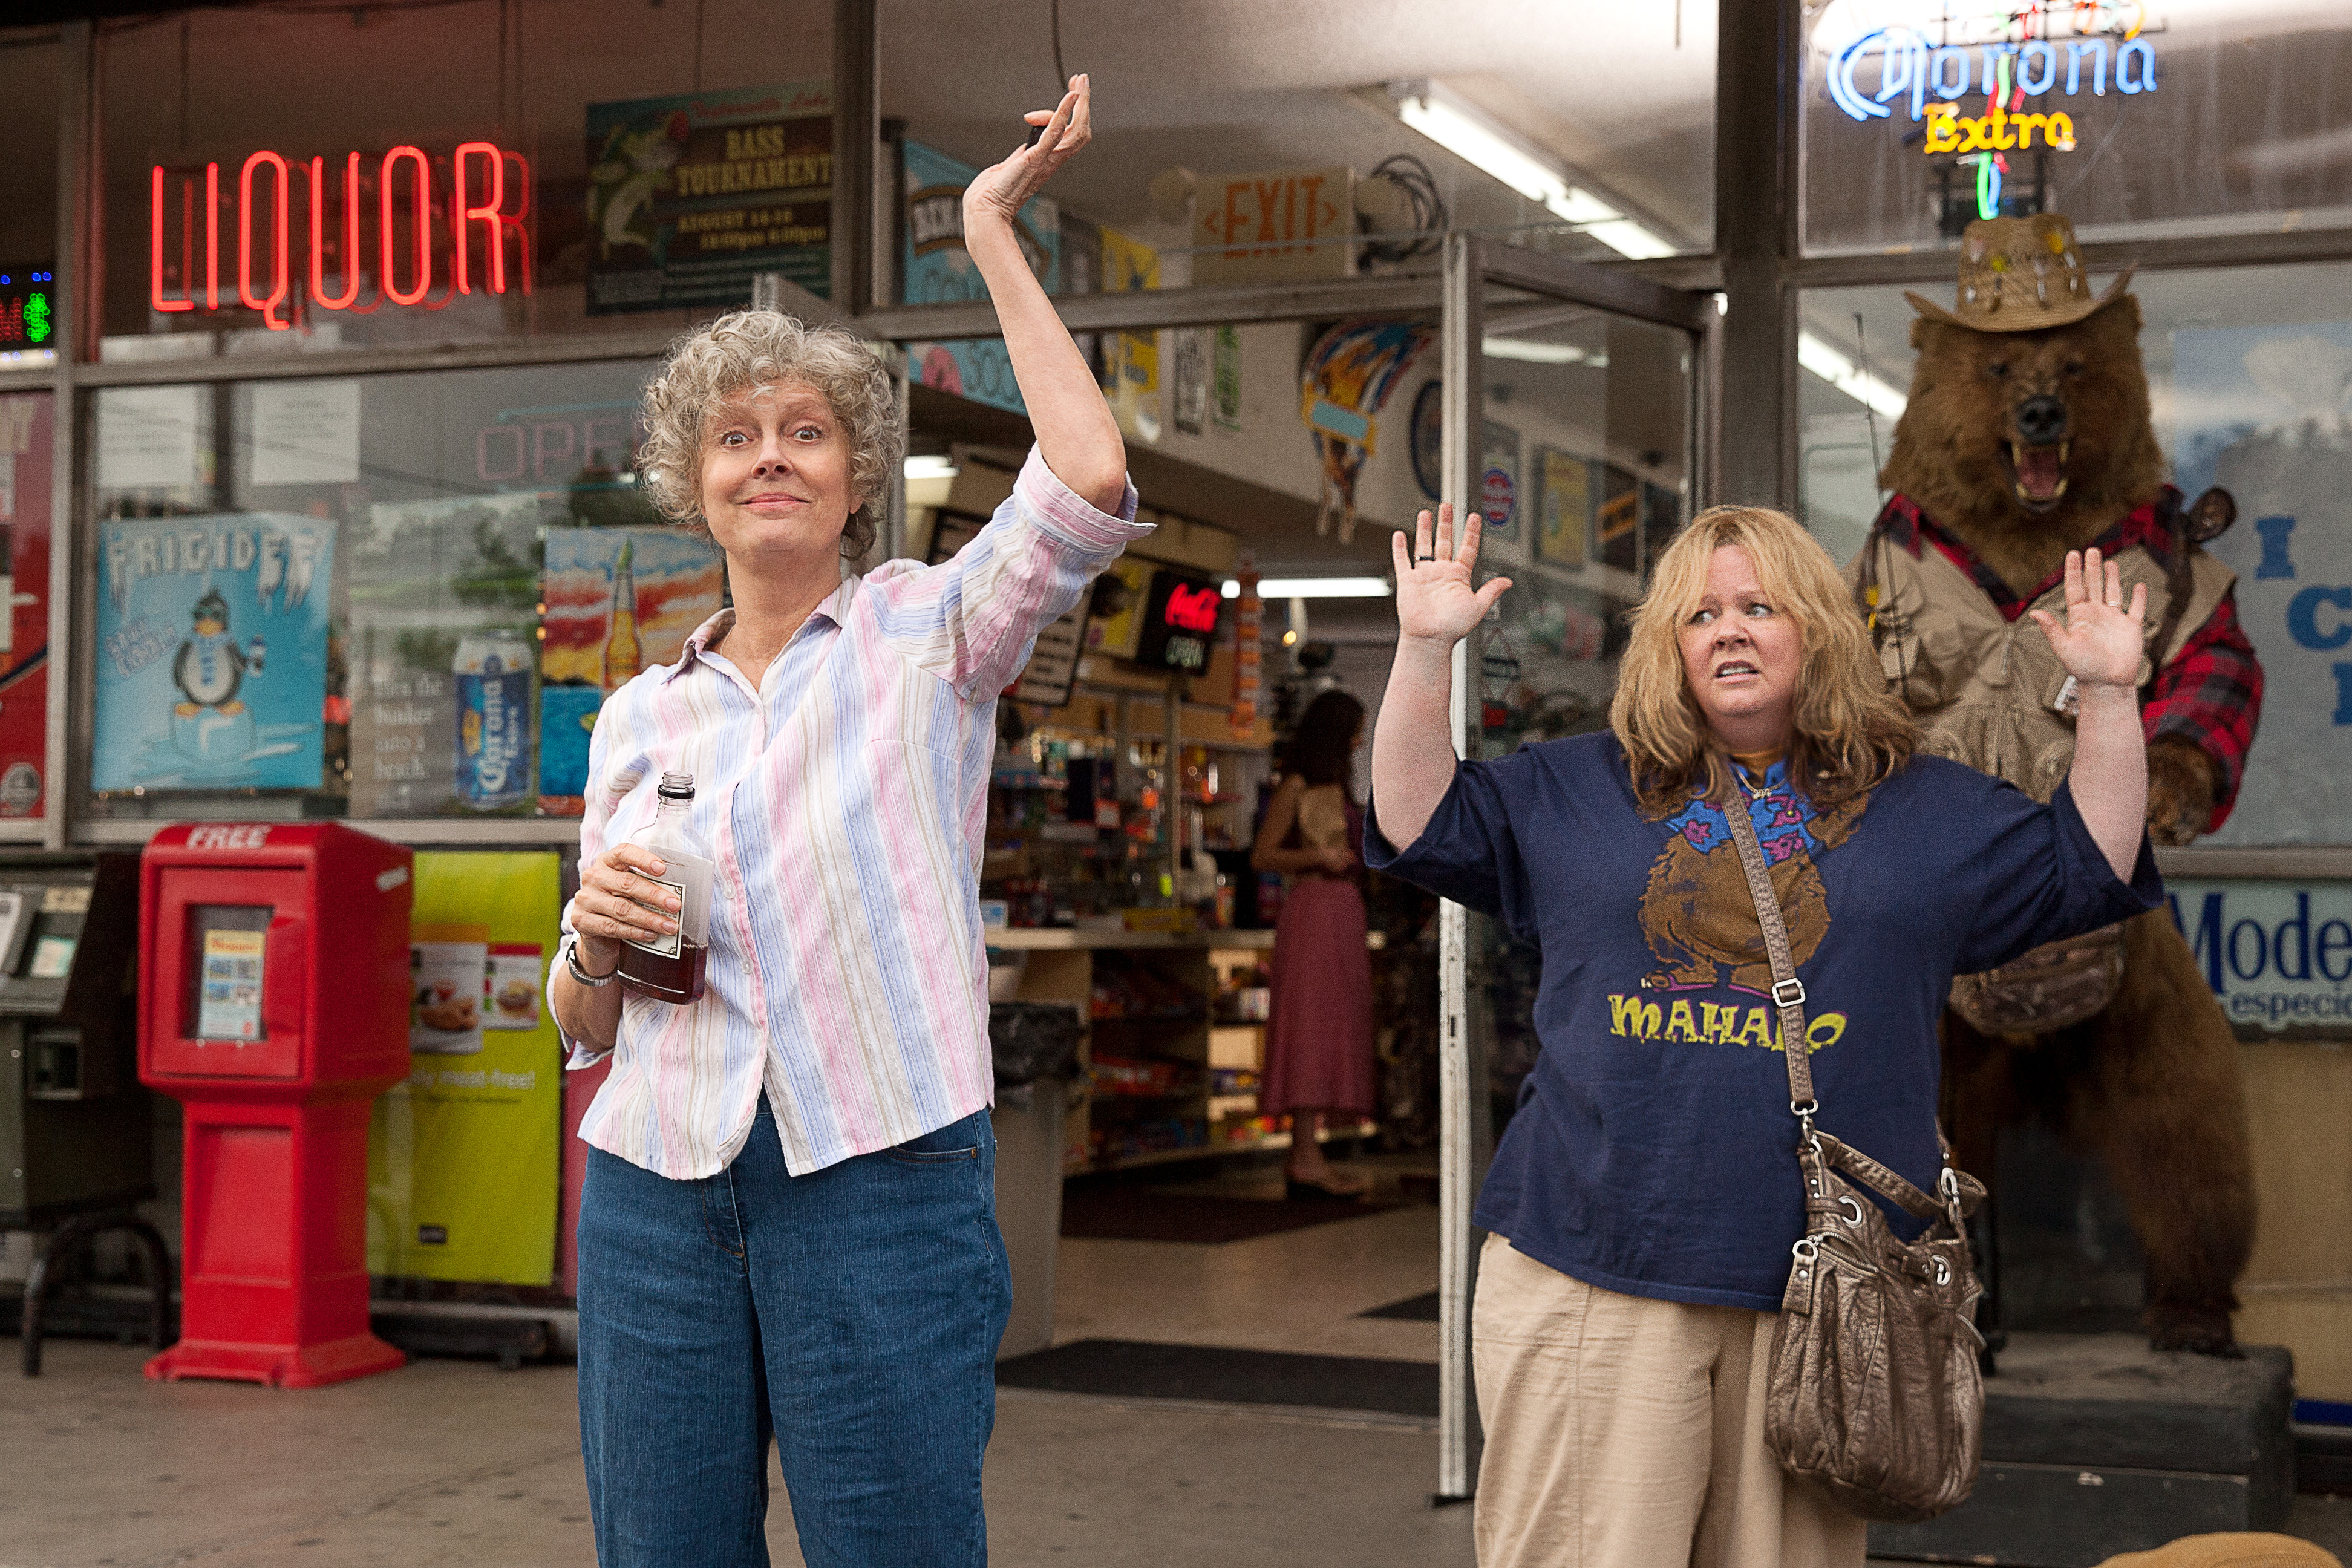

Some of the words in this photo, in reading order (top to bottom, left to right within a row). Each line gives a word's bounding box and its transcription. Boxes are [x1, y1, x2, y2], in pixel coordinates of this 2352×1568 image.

[1826, 25, 2158, 121] Corona
[726, 126, 785, 160] BASS
[1923, 102, 2077, 154] Extra
[676, 154, 833, 197] TOURNAMENT
[151, 142, 506, 331] LIQUOR
[1223, 175, 1325, 260] EXIT
[477, 417, 647, 481] OPE
[479, 679, 508, 793] Corona
[503, 707, 520, 758] Extra
[189, 824, 273, 849] FREE
[1607, 993, 1848, 1054] MAHAO
